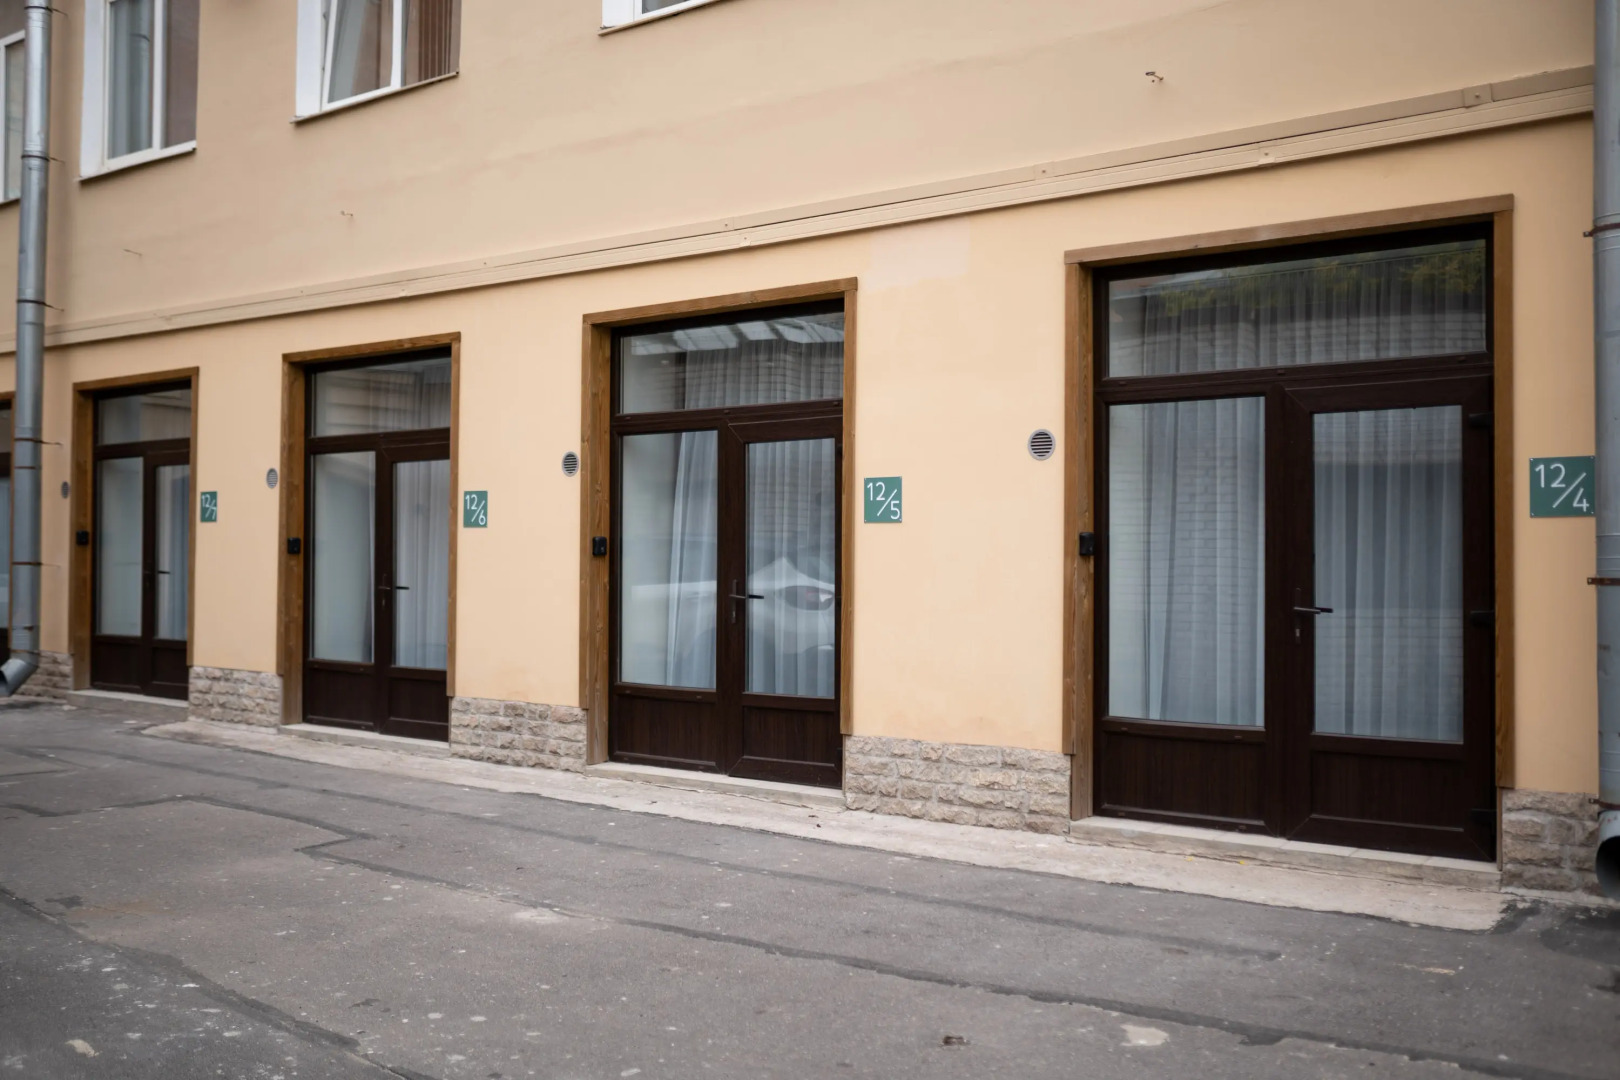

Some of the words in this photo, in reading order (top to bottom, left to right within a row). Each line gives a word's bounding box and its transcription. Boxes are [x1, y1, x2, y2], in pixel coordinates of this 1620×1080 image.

[867, 481, 900, 520] 12/5
[1535, 463, 1590, 512] 12/4
[465, 494, 486, 525] 12/6
